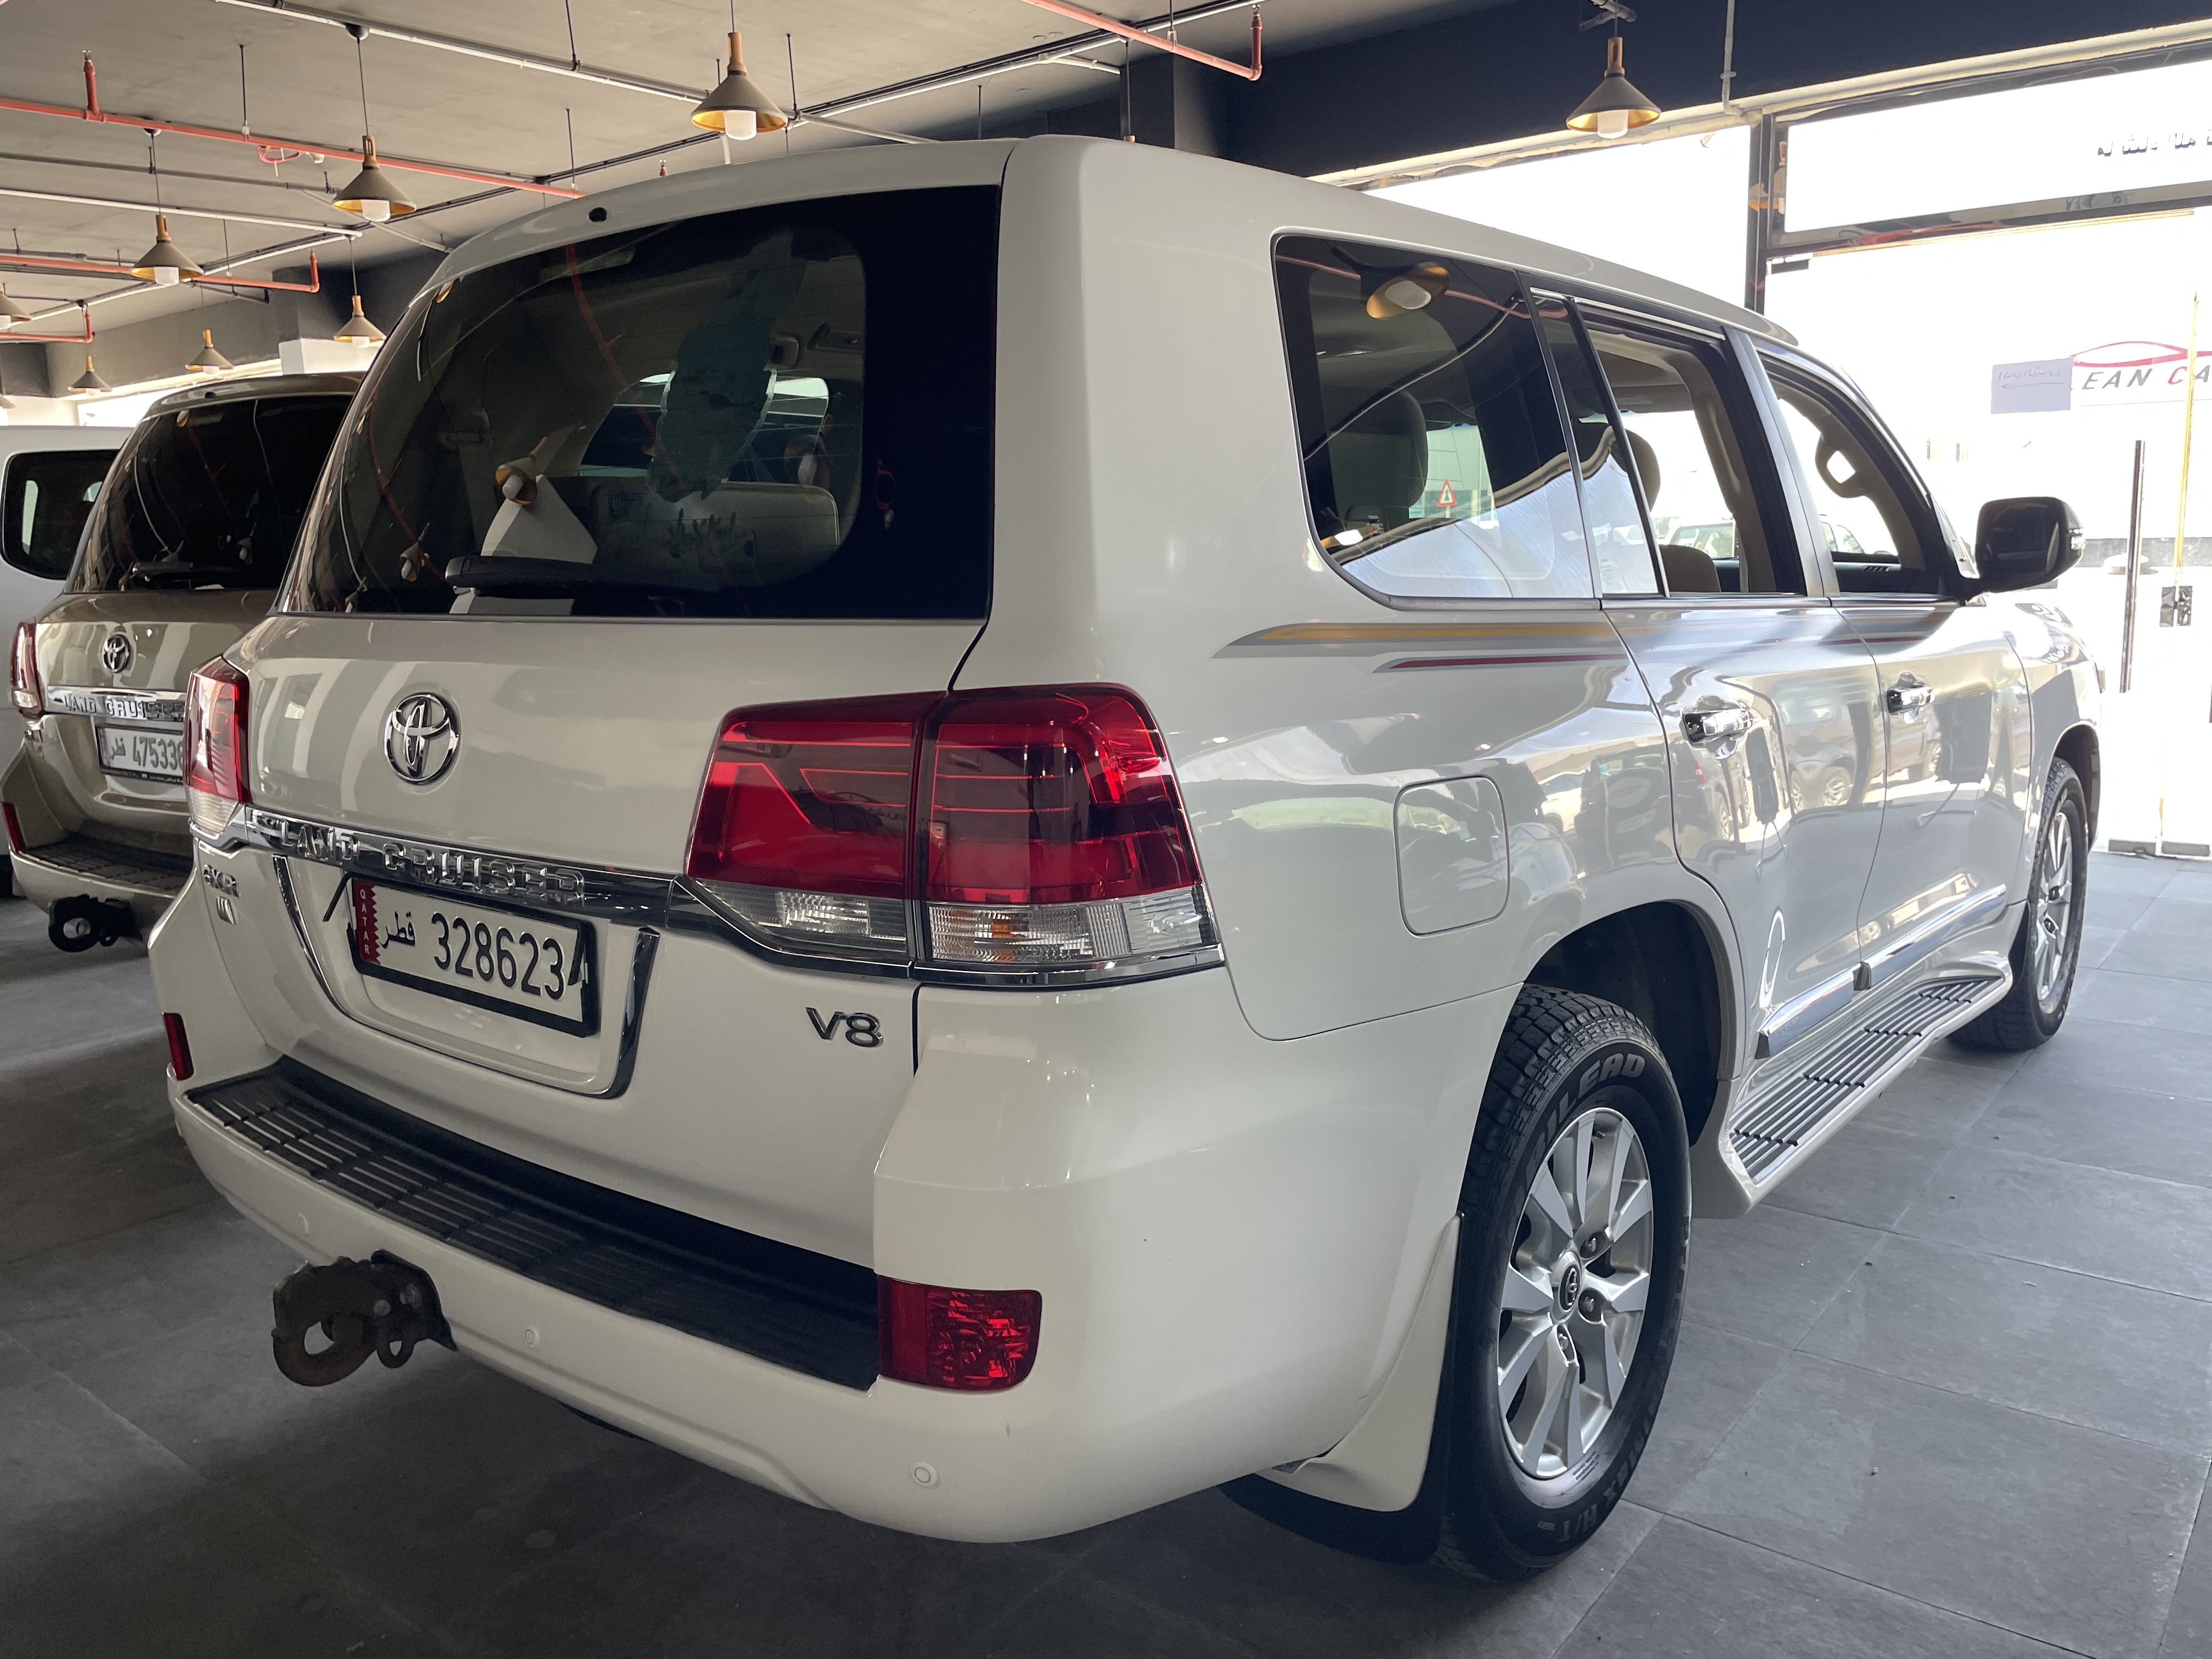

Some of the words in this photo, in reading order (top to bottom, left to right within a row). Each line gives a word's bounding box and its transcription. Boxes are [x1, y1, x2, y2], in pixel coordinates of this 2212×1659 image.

[64, 693, 97, 713] LAND
[280, 819, 360, 864] LAND
[382, 841, 585, 905] CRUISER
[360, 888, 370, 955] QATAR
[380, 910, 416, 949] قطر
[431, 911, 566, 1000] 328623
[805, 1007, 884, 1048] V8
